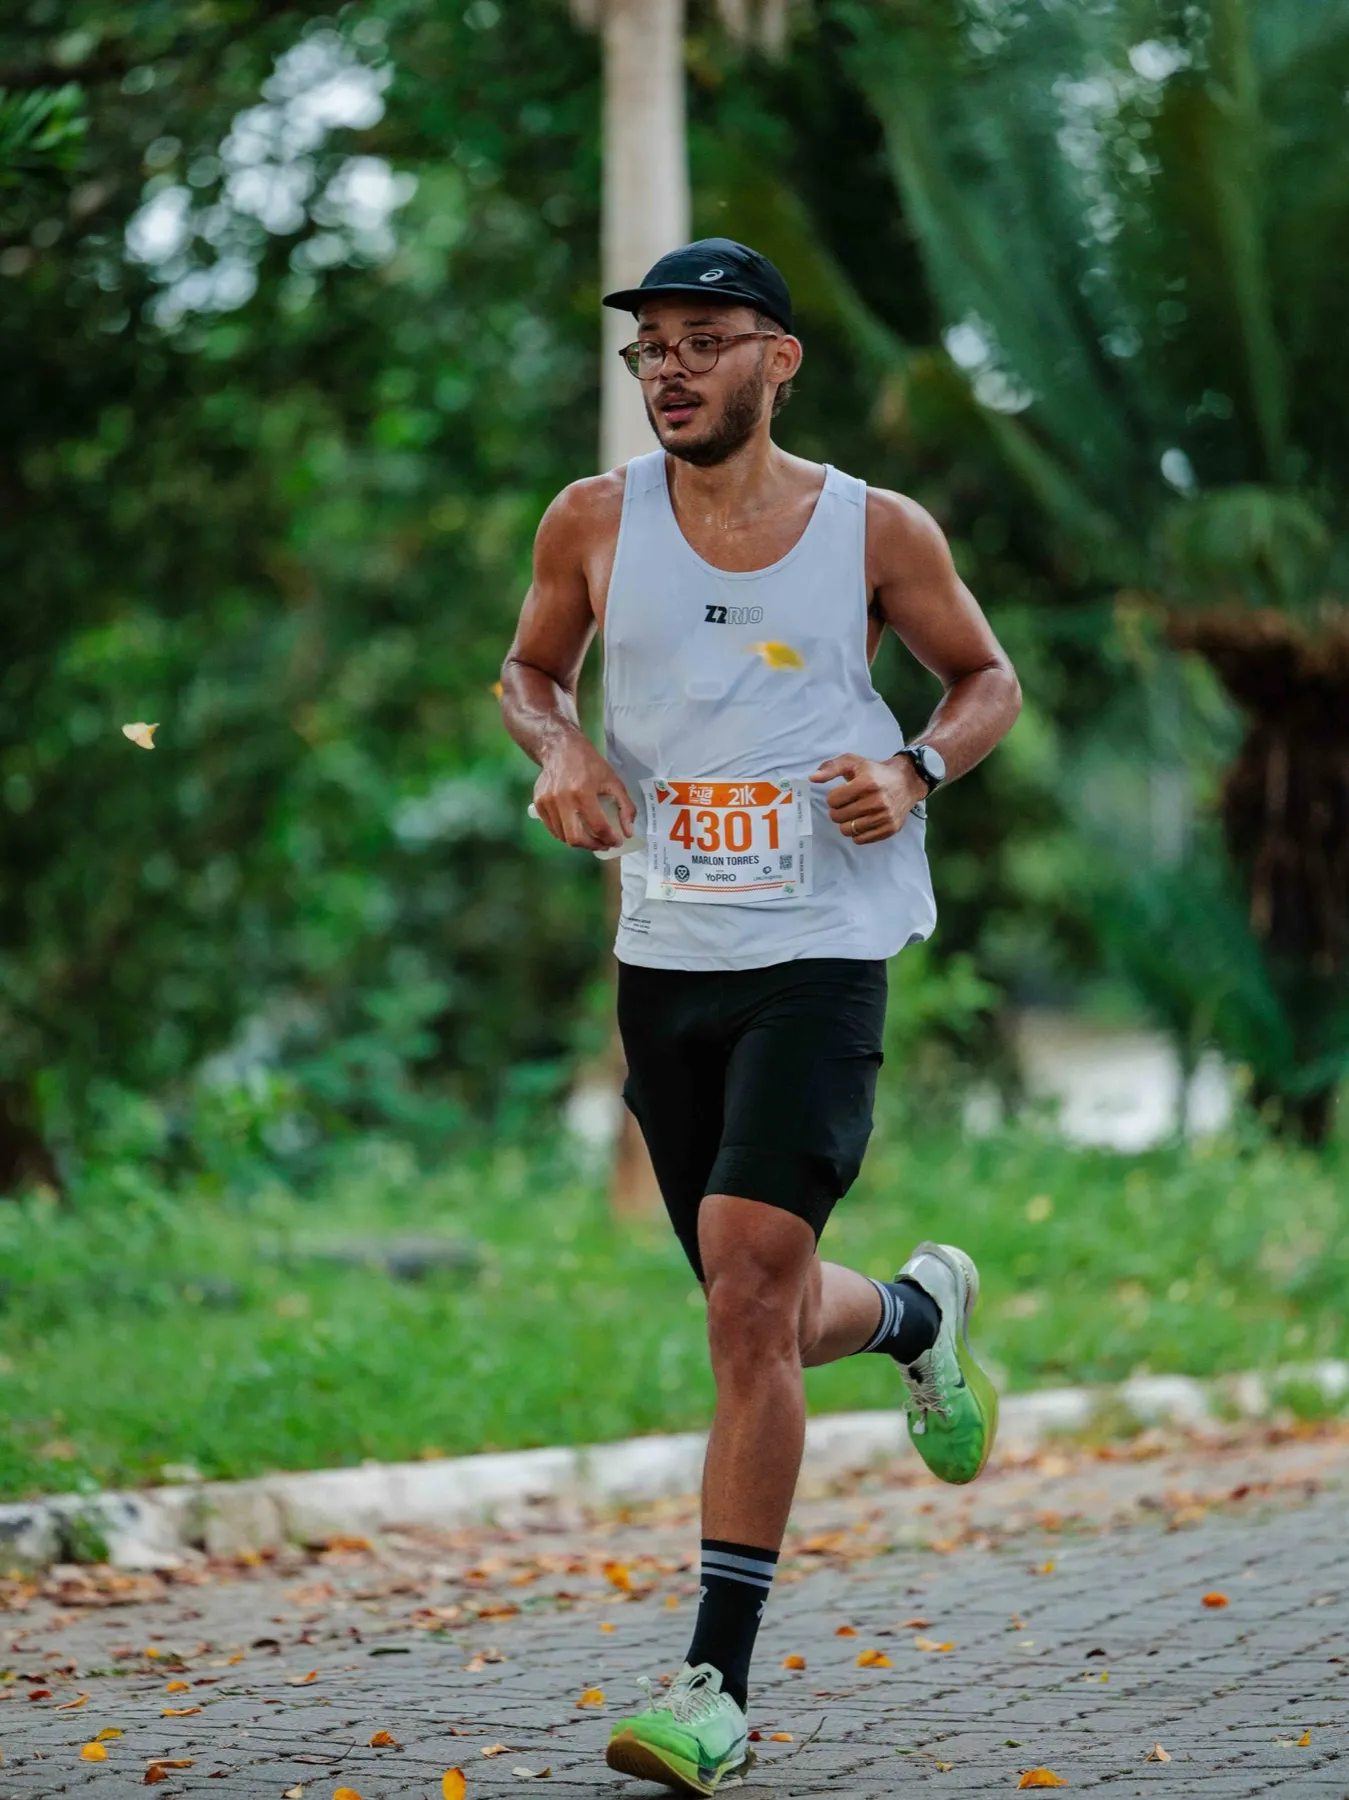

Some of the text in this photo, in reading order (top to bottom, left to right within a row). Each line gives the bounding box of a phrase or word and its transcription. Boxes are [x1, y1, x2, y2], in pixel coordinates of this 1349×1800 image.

[669, 808, 779, 852] 4301
[691, 855, 760, 866] MARLON TORRES
[705, 873, 737, 882] YoPRO
